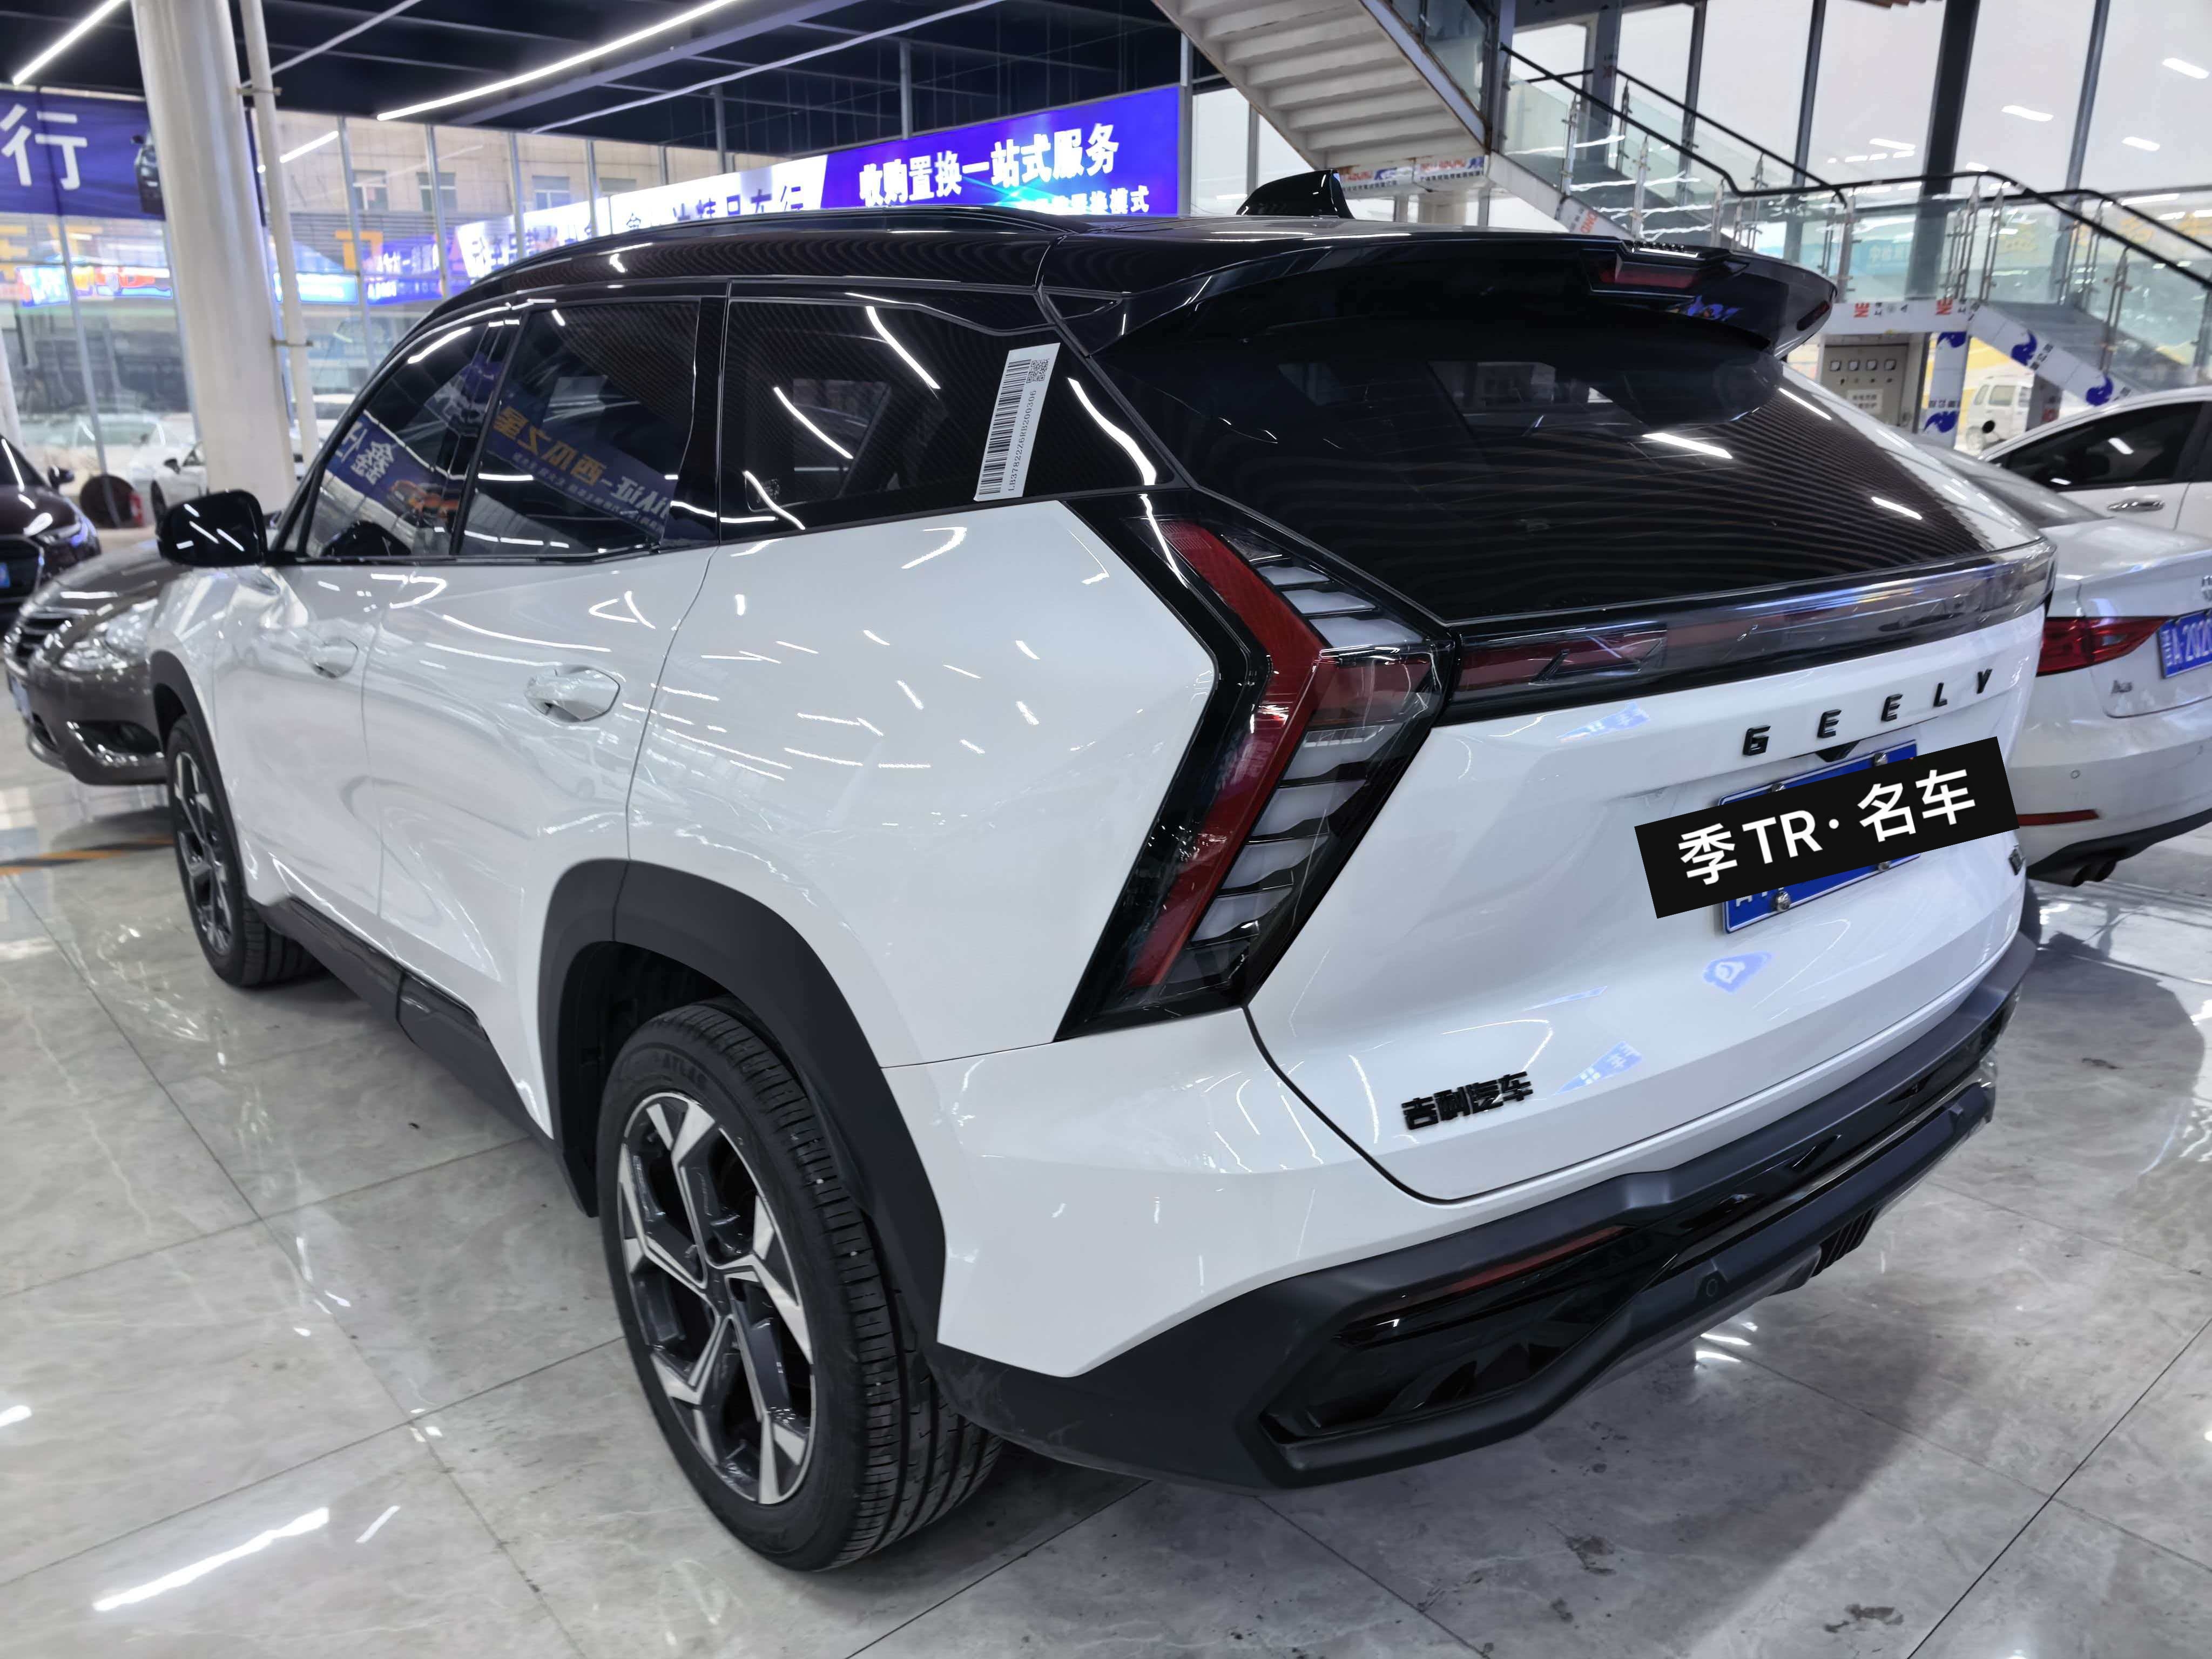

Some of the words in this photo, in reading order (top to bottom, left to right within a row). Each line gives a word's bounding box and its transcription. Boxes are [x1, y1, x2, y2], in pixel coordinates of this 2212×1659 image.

[0, 104, 88, 191] 行
[859, 123, 1120, 208] 收购置换一站式服务
[1742, 669, 1993, 757] GEELY
[1401, 1071, 1534, 1130] 吉利汽车
